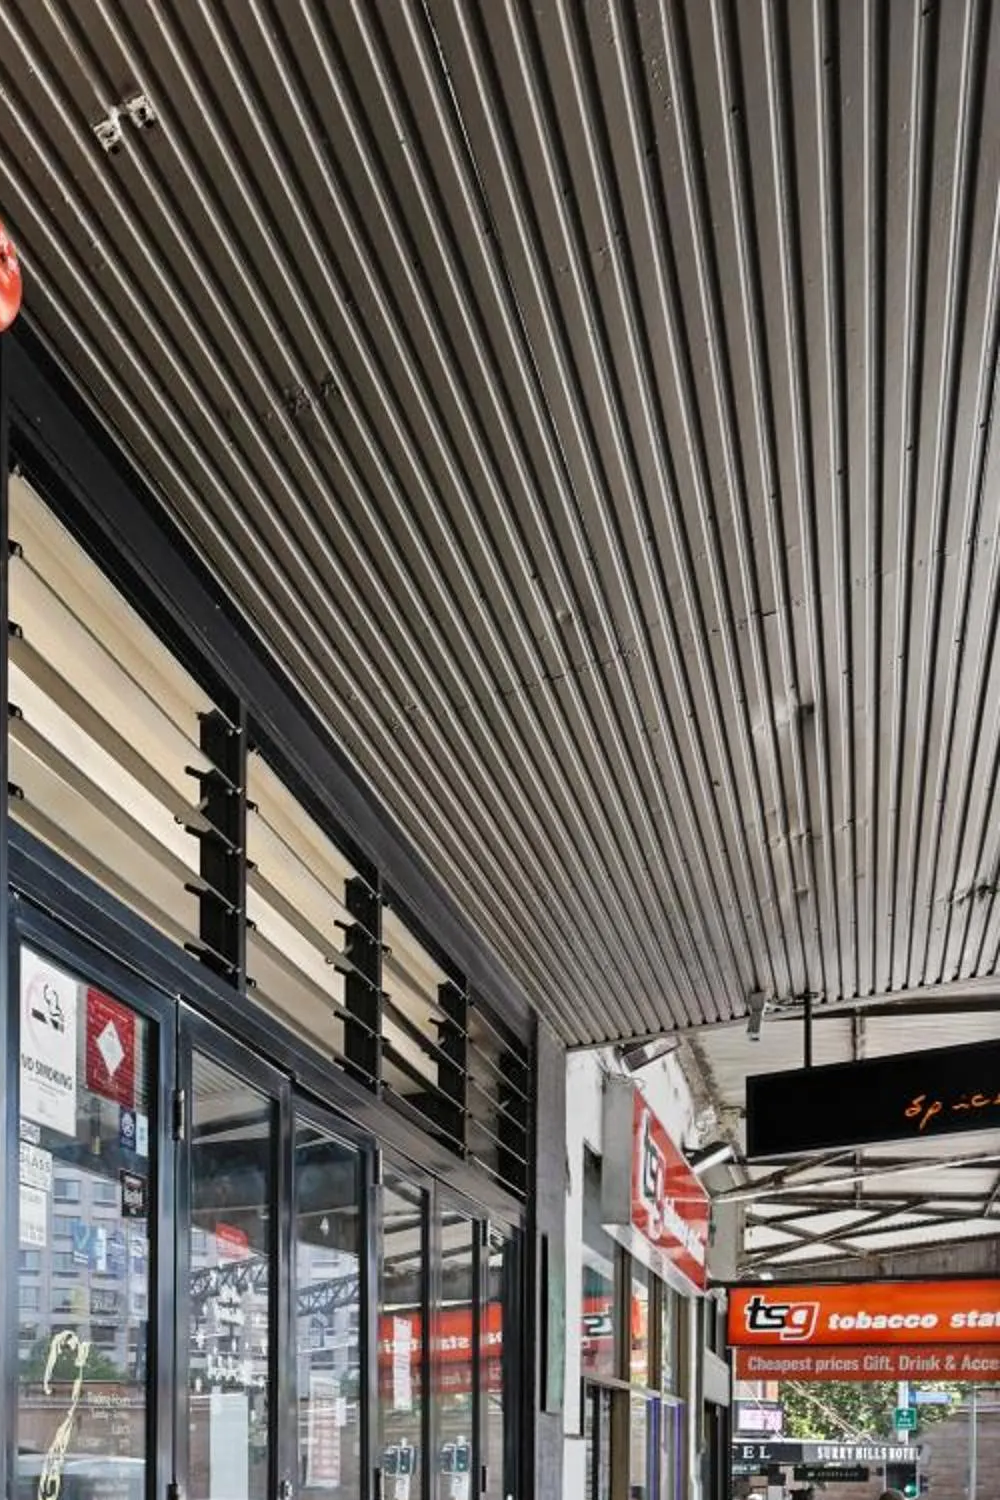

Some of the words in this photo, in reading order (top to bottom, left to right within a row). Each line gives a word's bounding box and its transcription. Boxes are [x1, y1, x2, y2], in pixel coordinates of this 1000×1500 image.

[744, 1295, 820, 1341] tsg
[828, 1311, 939, 1330] tobacco
[748, 1356, 811, 1372] Cheapest
[815, 1355, 858, 1372] prices
[863, 1352, 894, 1371] Gift,
[900, 1353, 939, 1370] Drink
[945, 1354, 956, 1370] &
[818, 1446, 854, 1460] SURRY
[855, 1447, 886, 1460] HILLS
[889, 1447, 921, 1460] HOTEL
